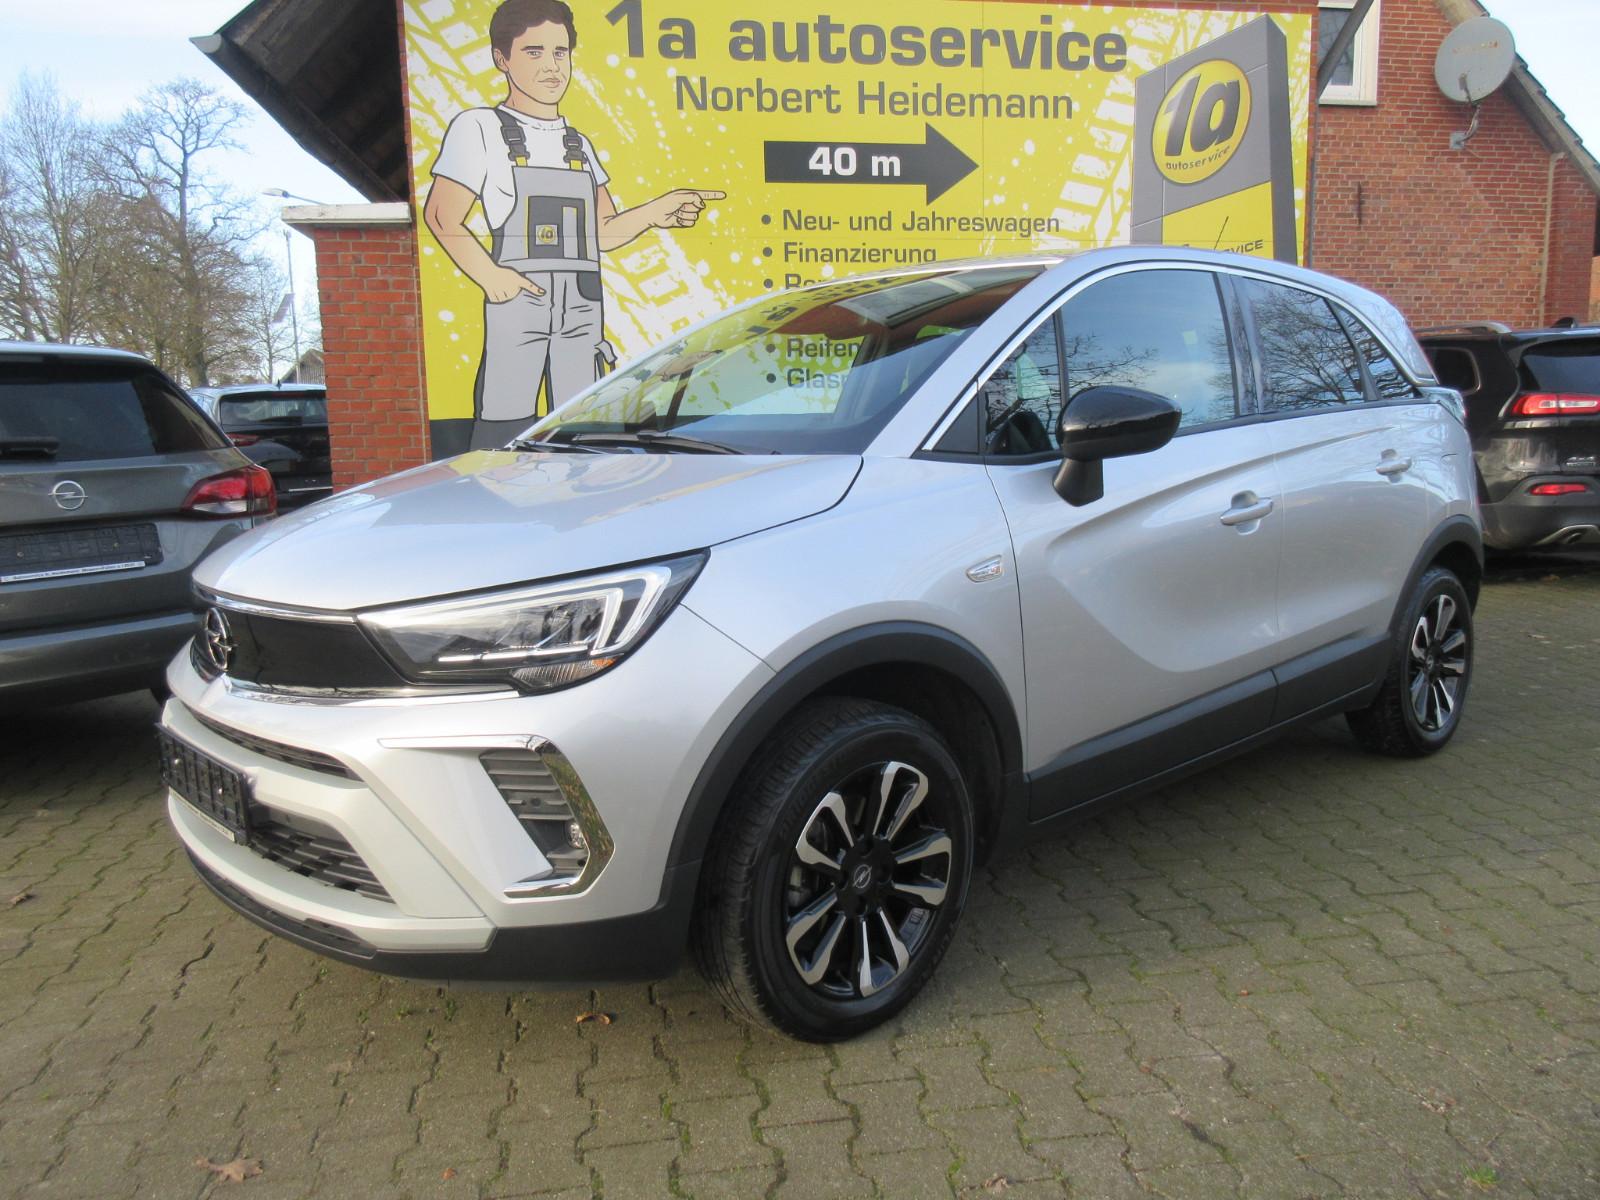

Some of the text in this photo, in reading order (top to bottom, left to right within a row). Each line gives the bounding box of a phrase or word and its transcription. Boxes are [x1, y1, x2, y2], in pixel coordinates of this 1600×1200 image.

[605, 0, 1128, 73] 1a autoservice
[675, 75, 1073, 120] Norbert Heidemann
[1163, 74, 1241, 157] 1a
[808, 146, 901, 177] 40 m
[1165, 145, 1231, 170] autoservice
[782, 209, 1060, 238] Neu- und Jahreswagen
[783, 241, 937, 263] Finanzierung
